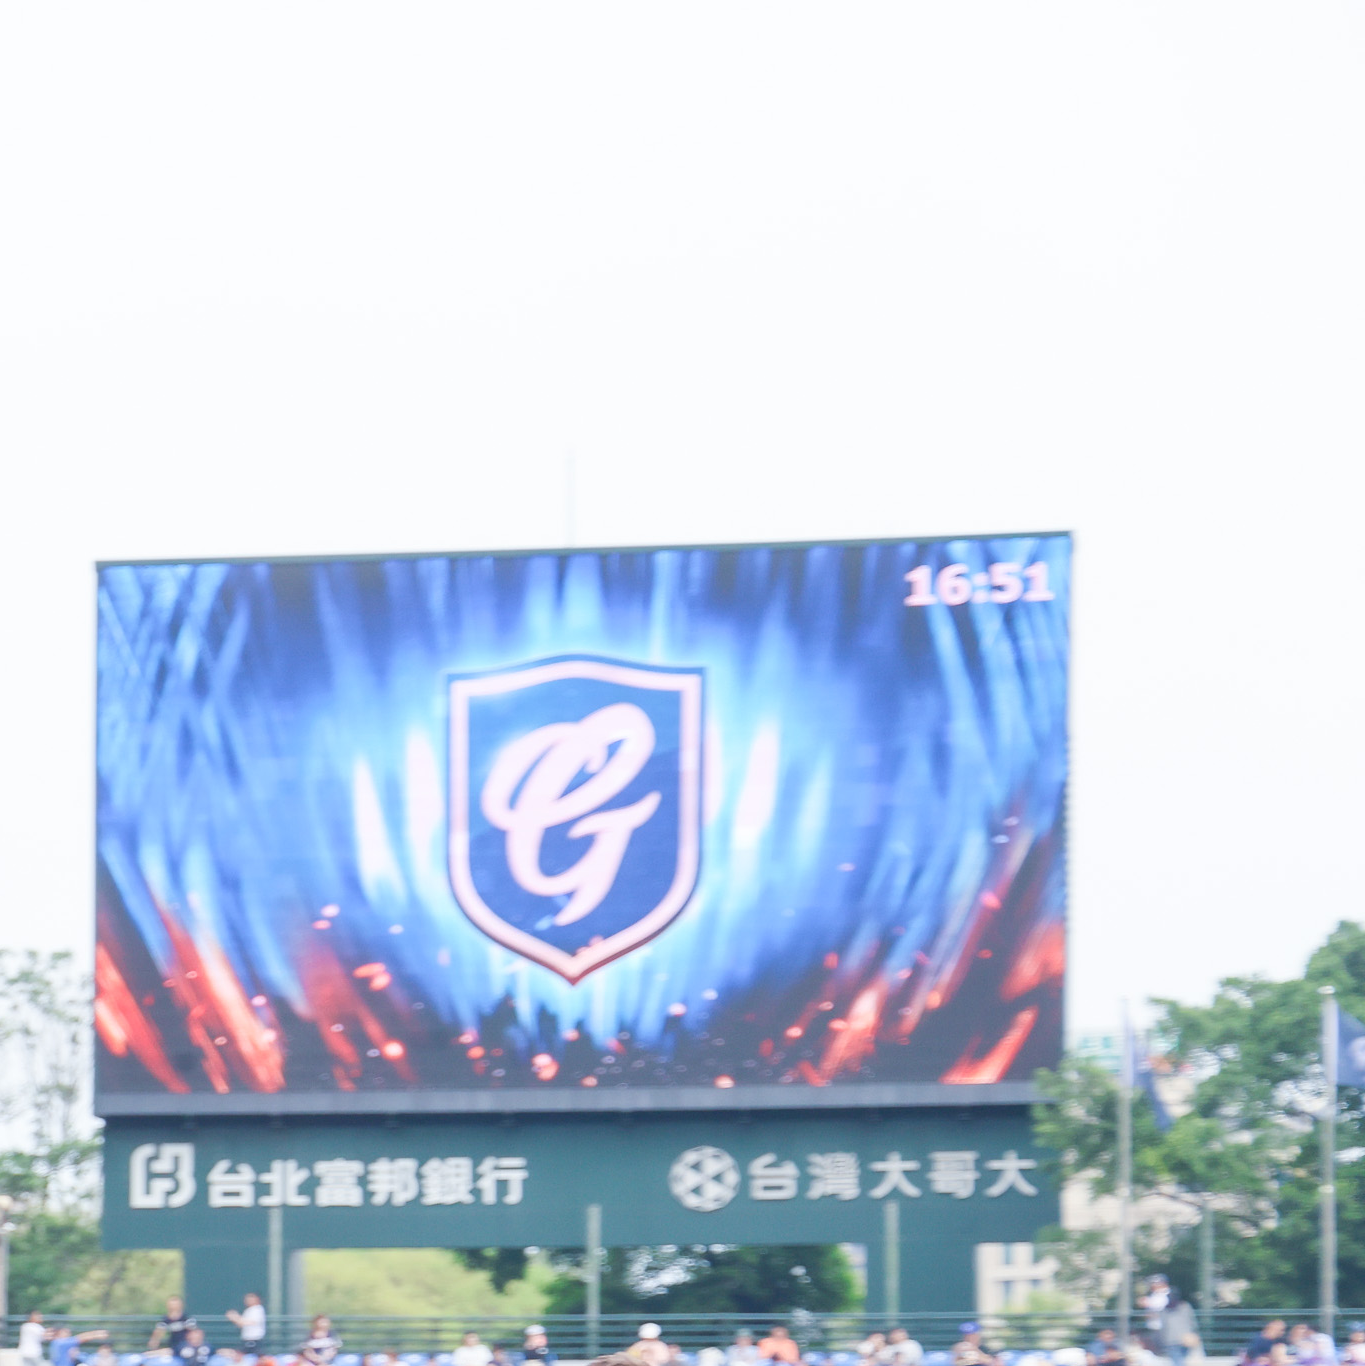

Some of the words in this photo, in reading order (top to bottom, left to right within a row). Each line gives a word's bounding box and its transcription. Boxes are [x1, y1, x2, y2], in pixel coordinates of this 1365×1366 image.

[903, 561, 1056, 607] 16:51
[206, 1156, 529, 1208] 台北富邦銀行
[747, 1150, 1039, 1201] 台灣大哥大
